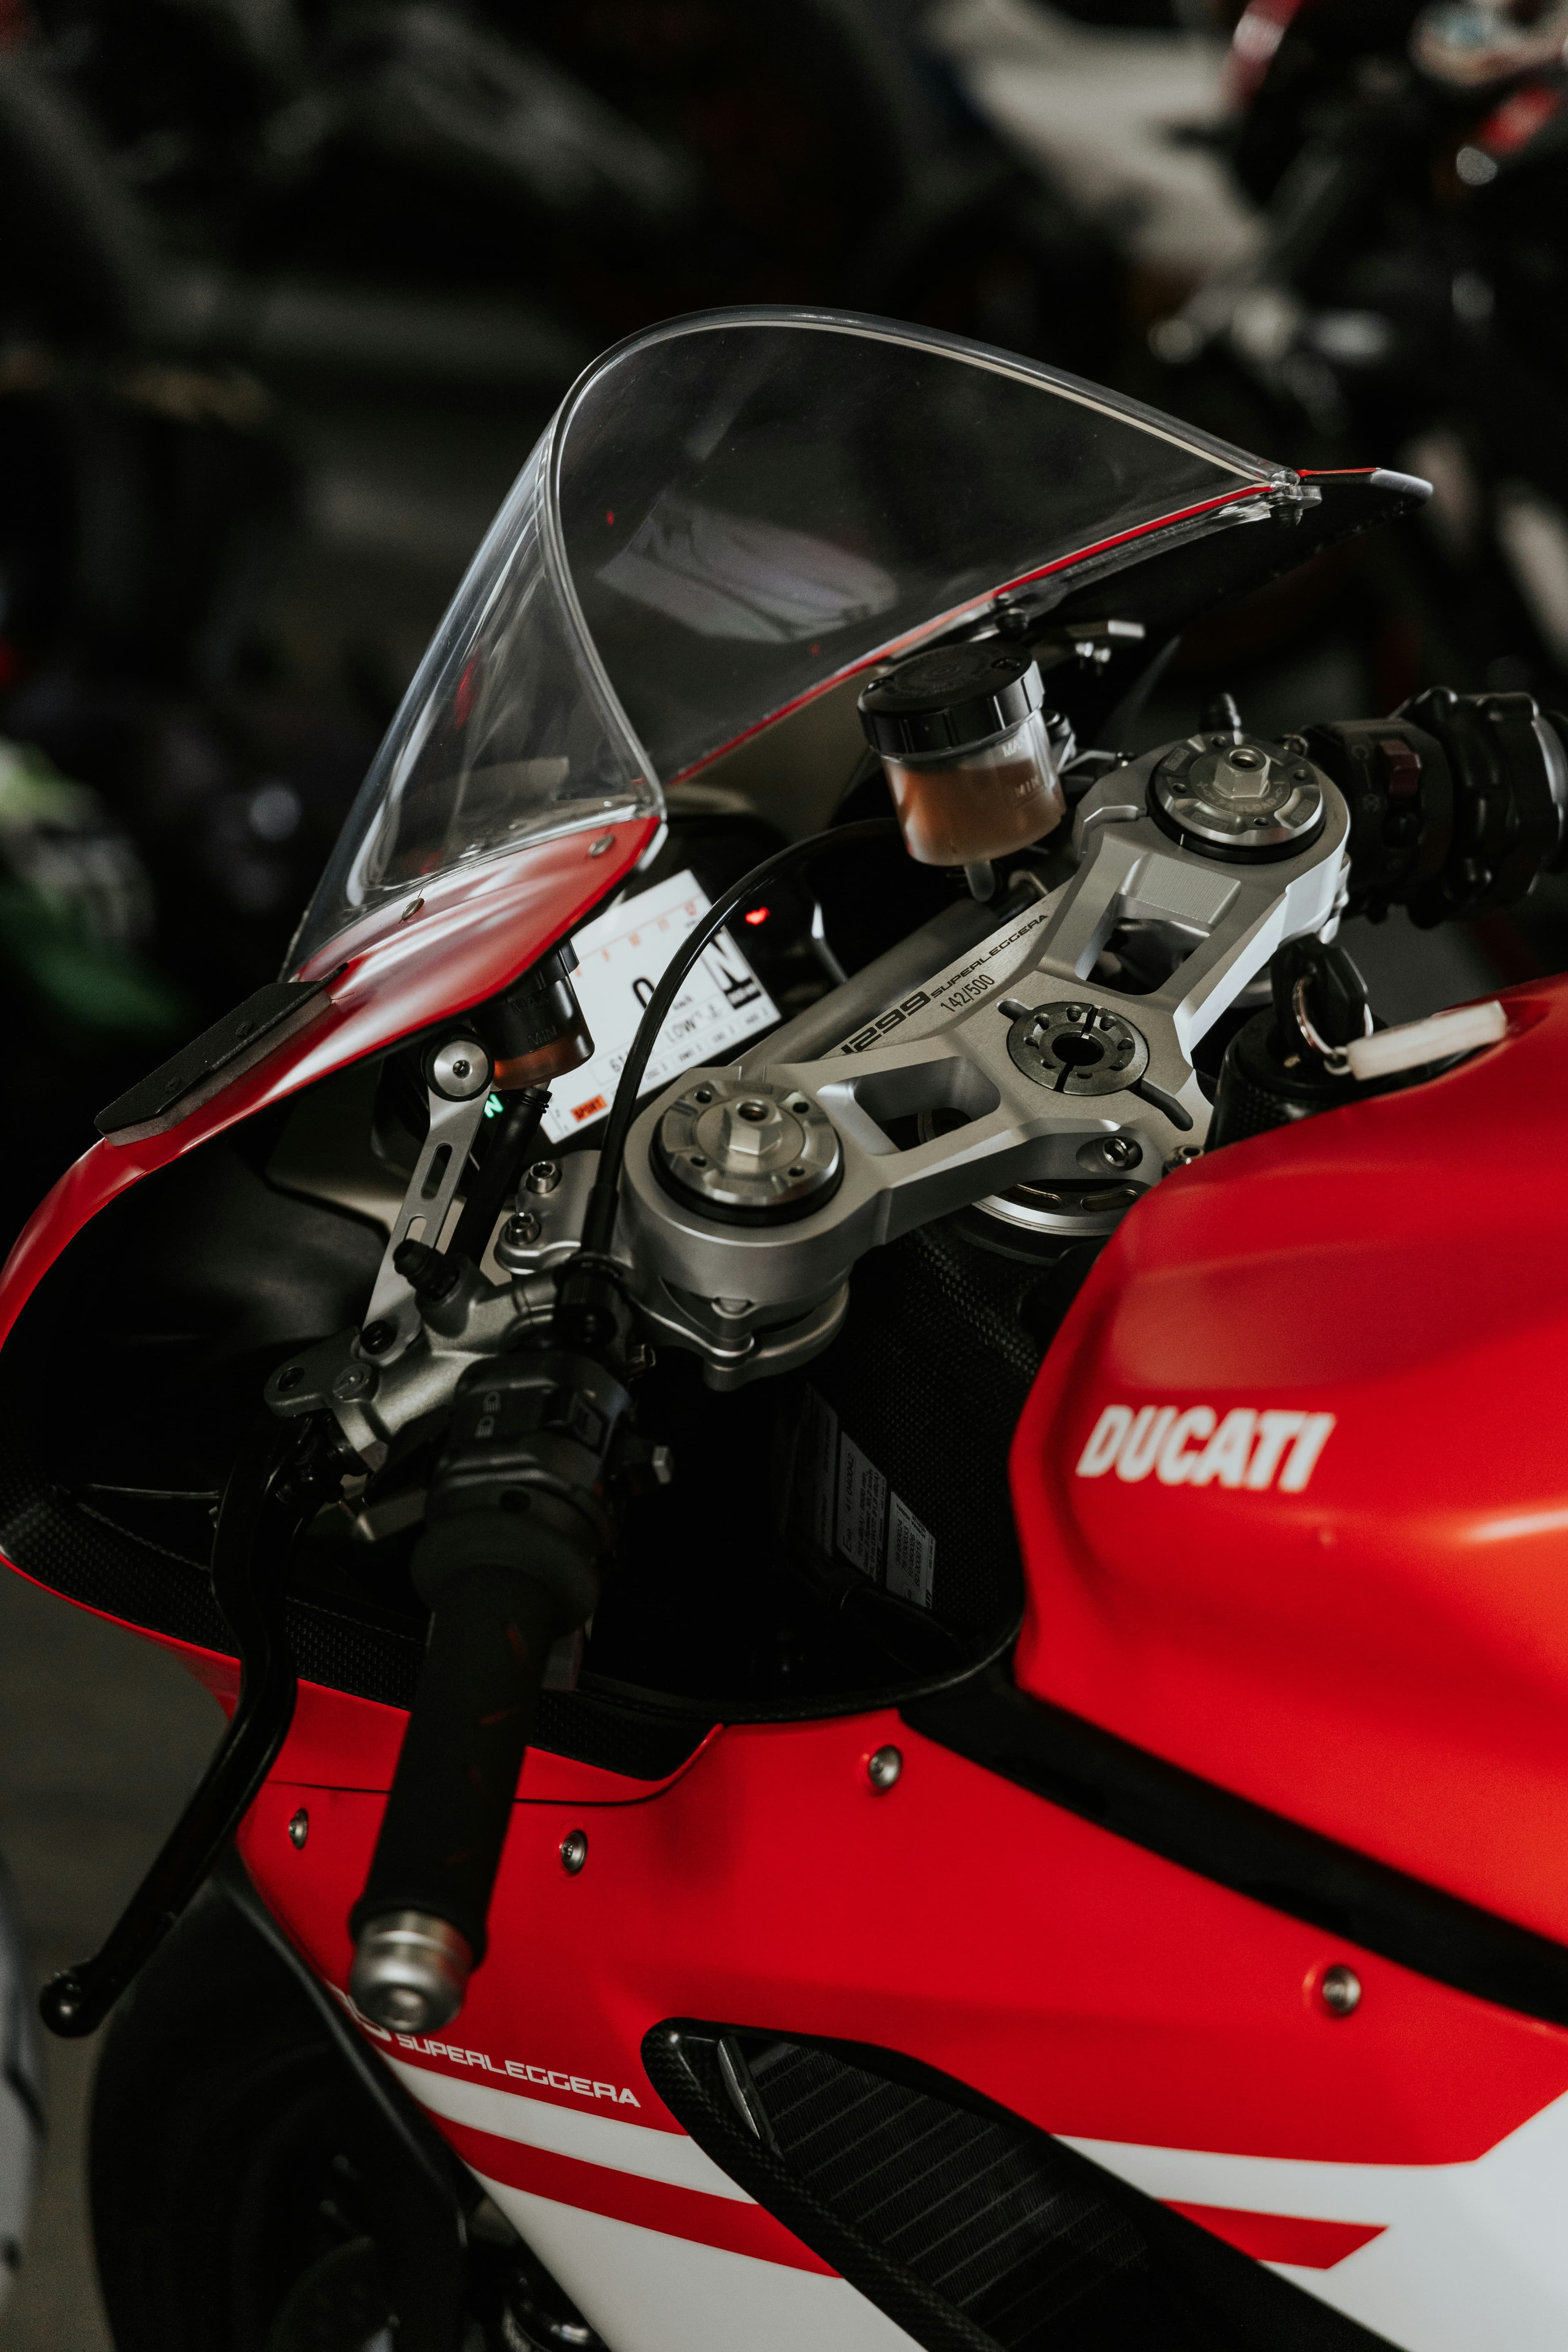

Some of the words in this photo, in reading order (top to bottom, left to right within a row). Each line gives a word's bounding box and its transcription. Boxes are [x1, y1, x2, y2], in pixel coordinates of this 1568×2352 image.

[840, 991, 931, 1054] 1299
[931, 915, 1048, 998] SUPERLEGGERA
[940, 974, 995, 1012] 142/500
[527, 1025, 557, 1047] MIN
[1075, 1403, 1338, 1494] DUCATI
[395, 2033, 641, 2108] SUPERLEGGERA
